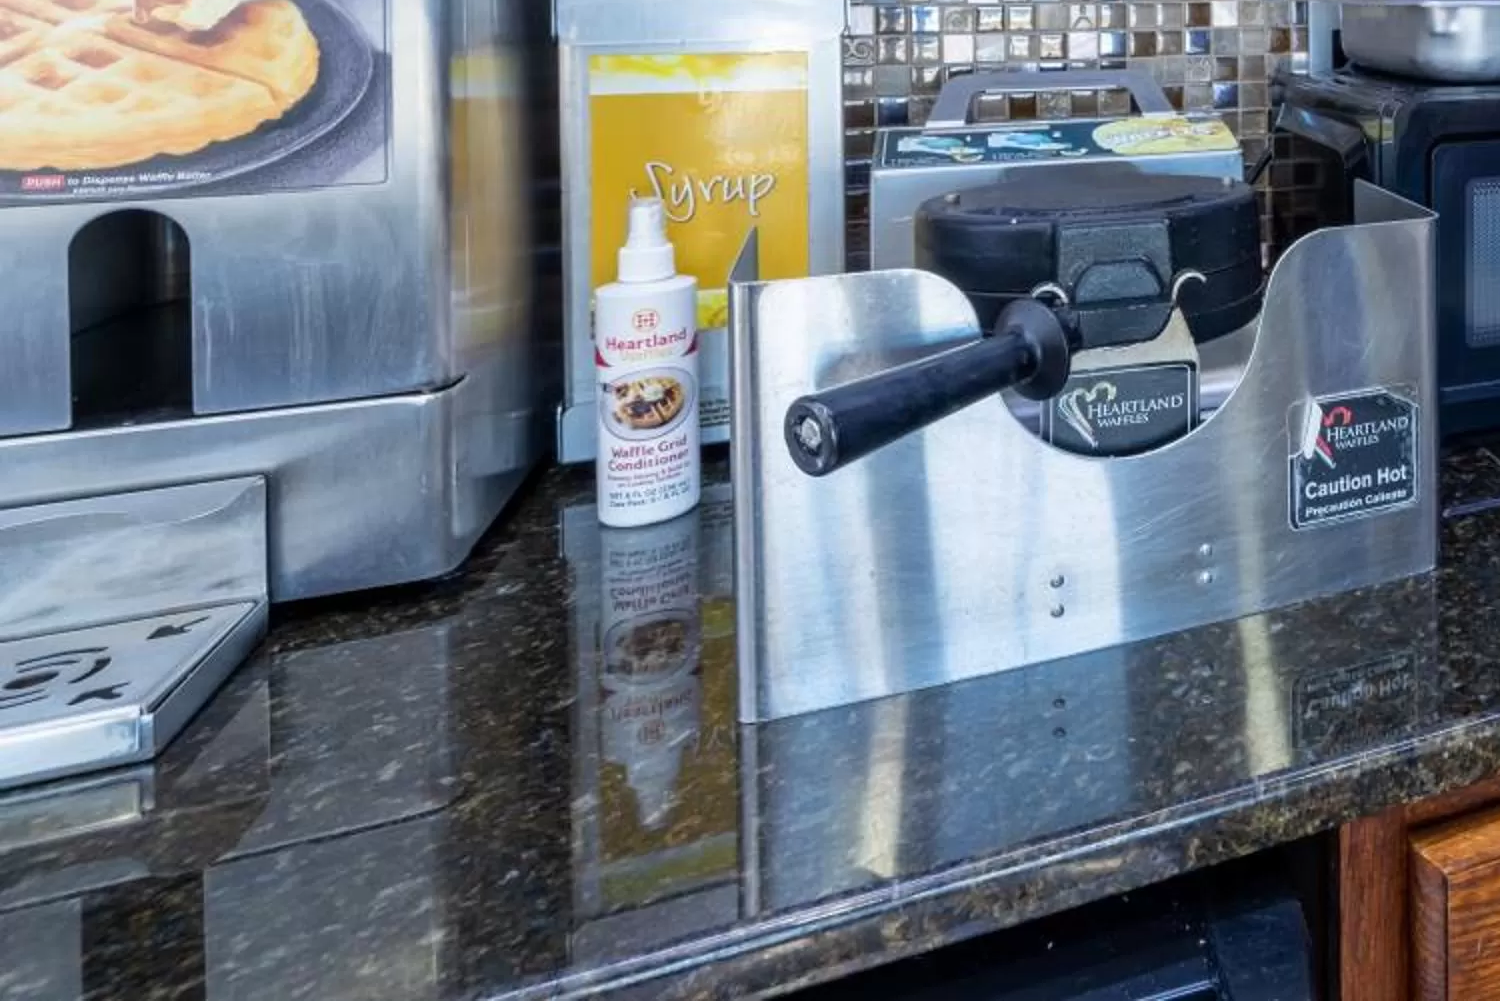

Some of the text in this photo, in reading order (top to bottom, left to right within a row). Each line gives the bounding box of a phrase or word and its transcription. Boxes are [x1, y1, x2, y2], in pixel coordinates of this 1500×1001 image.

[25, 170, 213, 189] PUSH to Dispense Waffle Batter
[630, 160, 776, 223] Syrup
[606, 327, 687, 352] Heartland
[1087, 393, 1184, 420] HEARTLAND
[1098, 412, 1150, 428] WAFFLES
[1326, 415, 1409, 443] HEARTLAND
[611, 433, 688, 459] Waffle Grid
[1335, 434, 1380, 451] WAFFLES
[608, 448, 690, 473] Conditioner
[1305, 463, 1408, 500] Caution Hot
